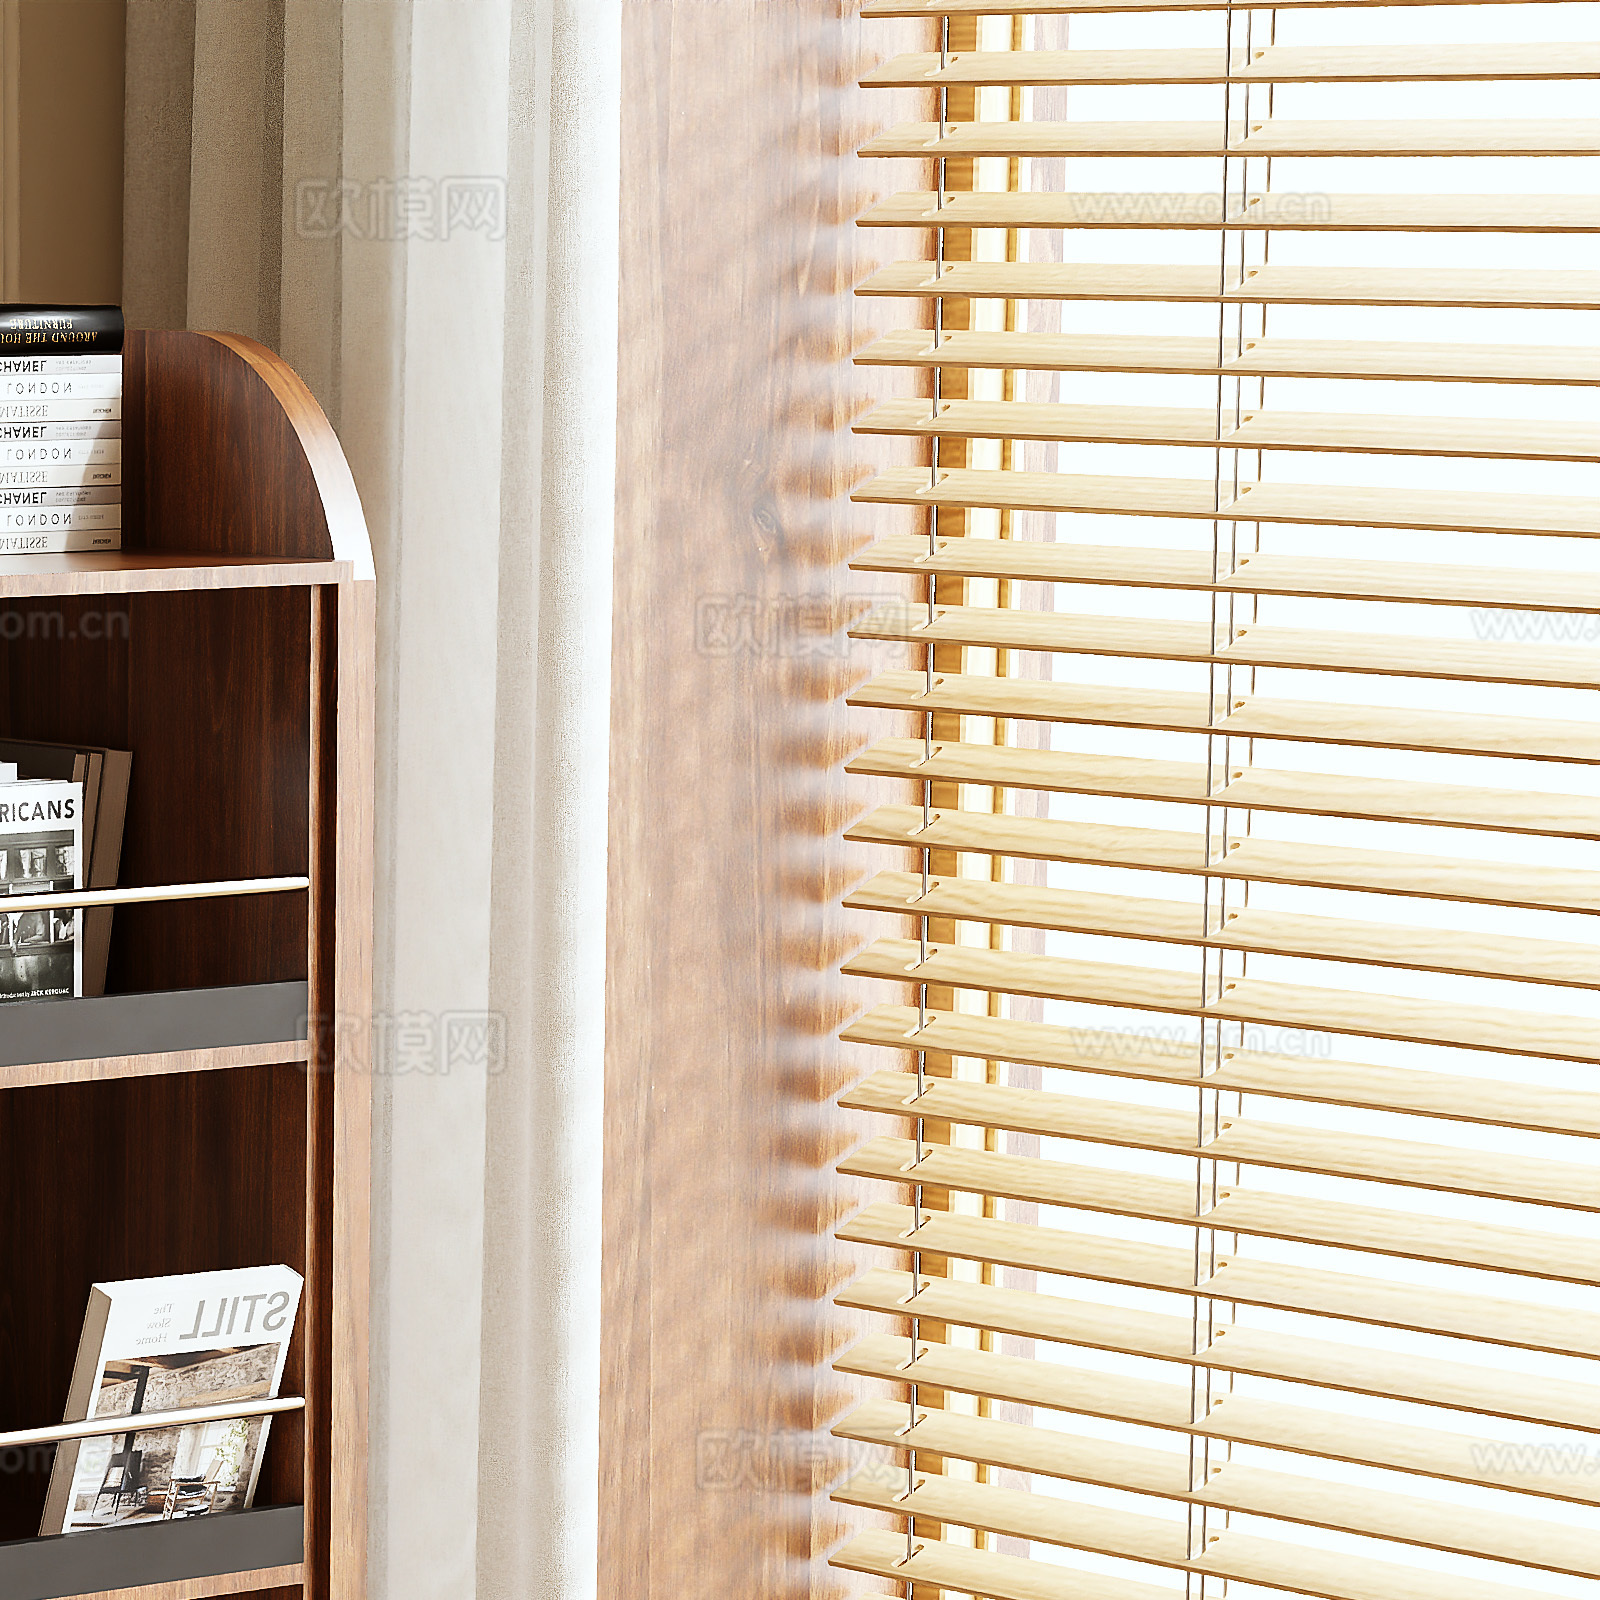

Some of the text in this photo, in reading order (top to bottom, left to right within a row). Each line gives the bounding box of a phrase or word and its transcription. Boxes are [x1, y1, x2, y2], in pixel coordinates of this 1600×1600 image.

[9, 318, 74, 330] FURNITURE
[25, 332, 48, 344] THE
[51, 331, 98, 343] AROUND
